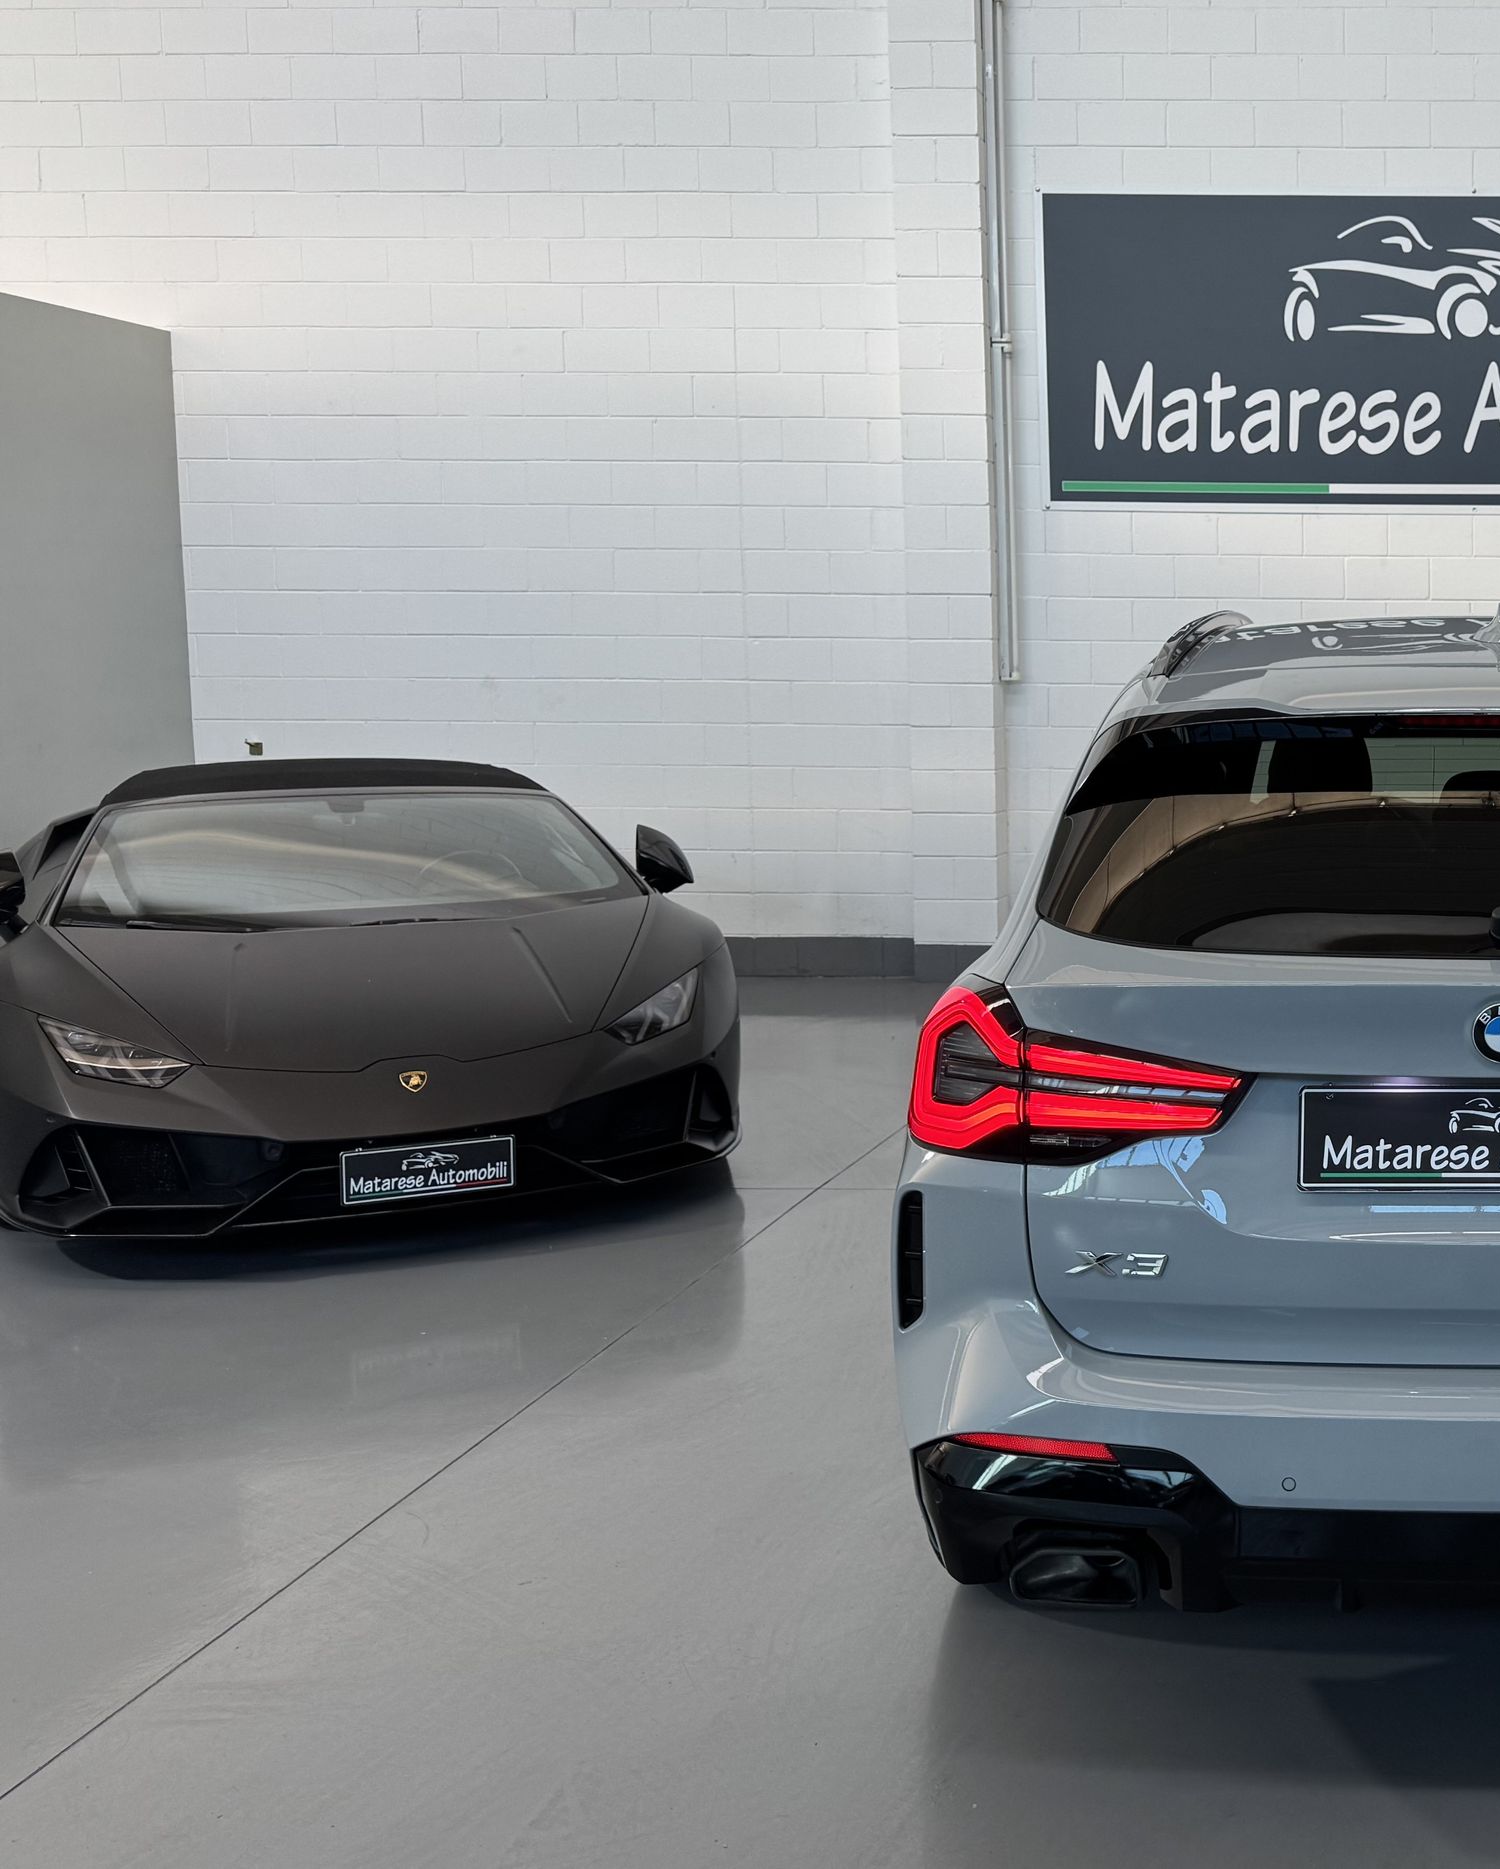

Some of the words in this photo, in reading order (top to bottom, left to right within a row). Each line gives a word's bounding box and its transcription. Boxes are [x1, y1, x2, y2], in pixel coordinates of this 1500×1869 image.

[1093, 360, 1442, 456] Matarese
[1322, 1134, 1490, 1171] Matarese
[350, 1174, 425, 1195] Matarese
[428, 1161, 507, 1186] Automobili
[1063, 1249, 1168, 1277] X3
